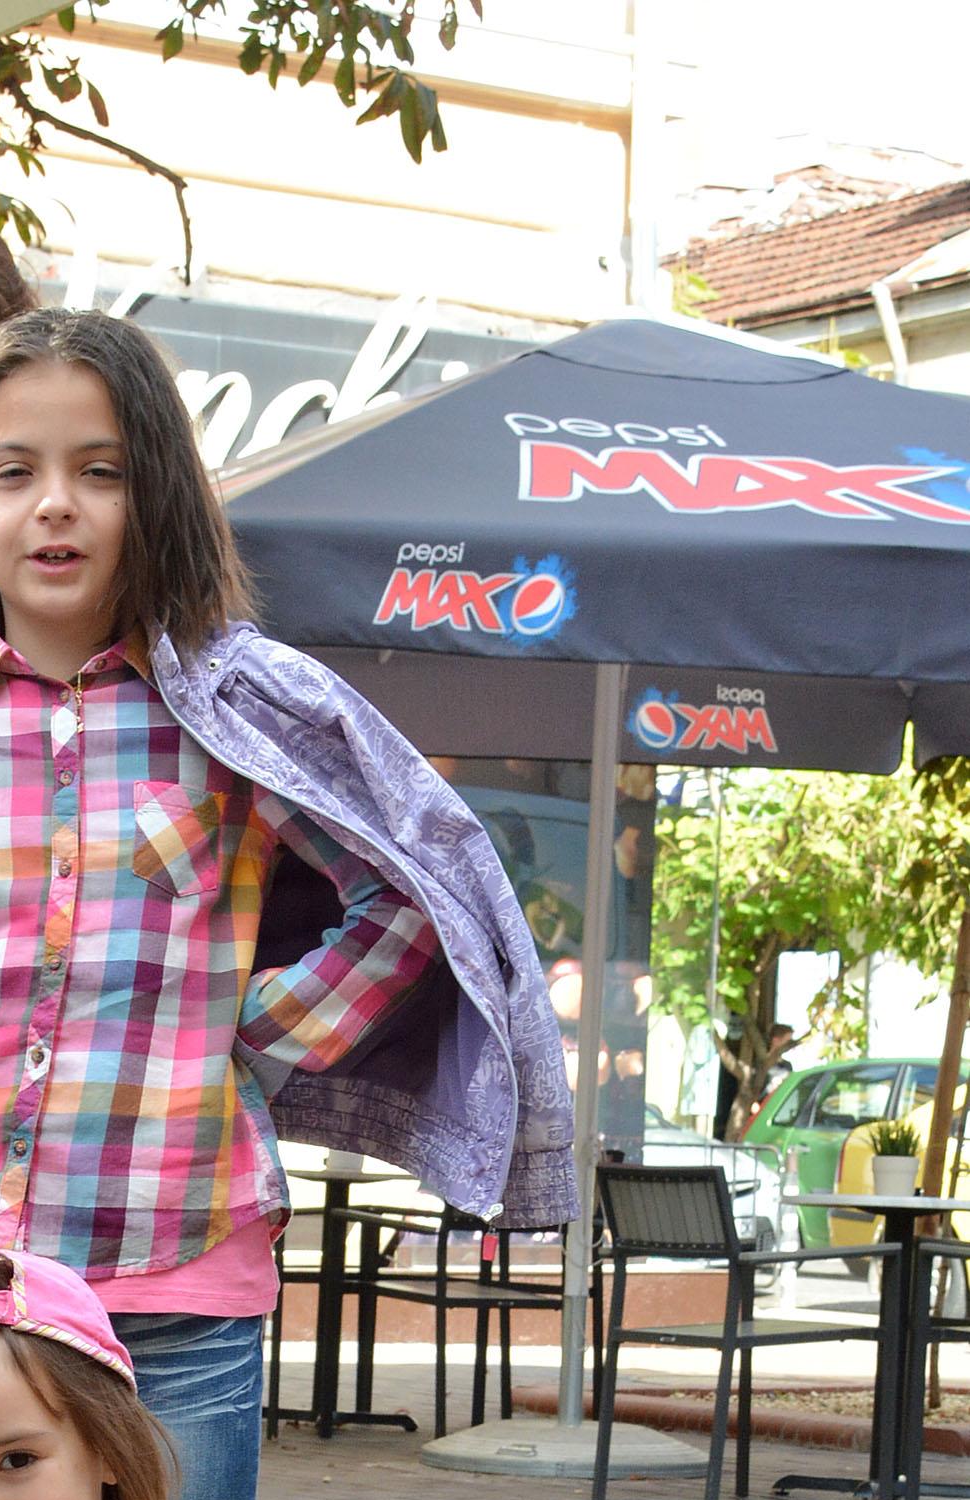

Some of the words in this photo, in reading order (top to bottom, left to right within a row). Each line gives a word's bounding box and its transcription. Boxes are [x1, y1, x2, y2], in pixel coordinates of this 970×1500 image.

[504, 412, 727, 447] pepsi
[518, 439, 970, 525] MAX
[396, 542, 466, 566] pepsi
[372, 567, 526, 633] MAX
